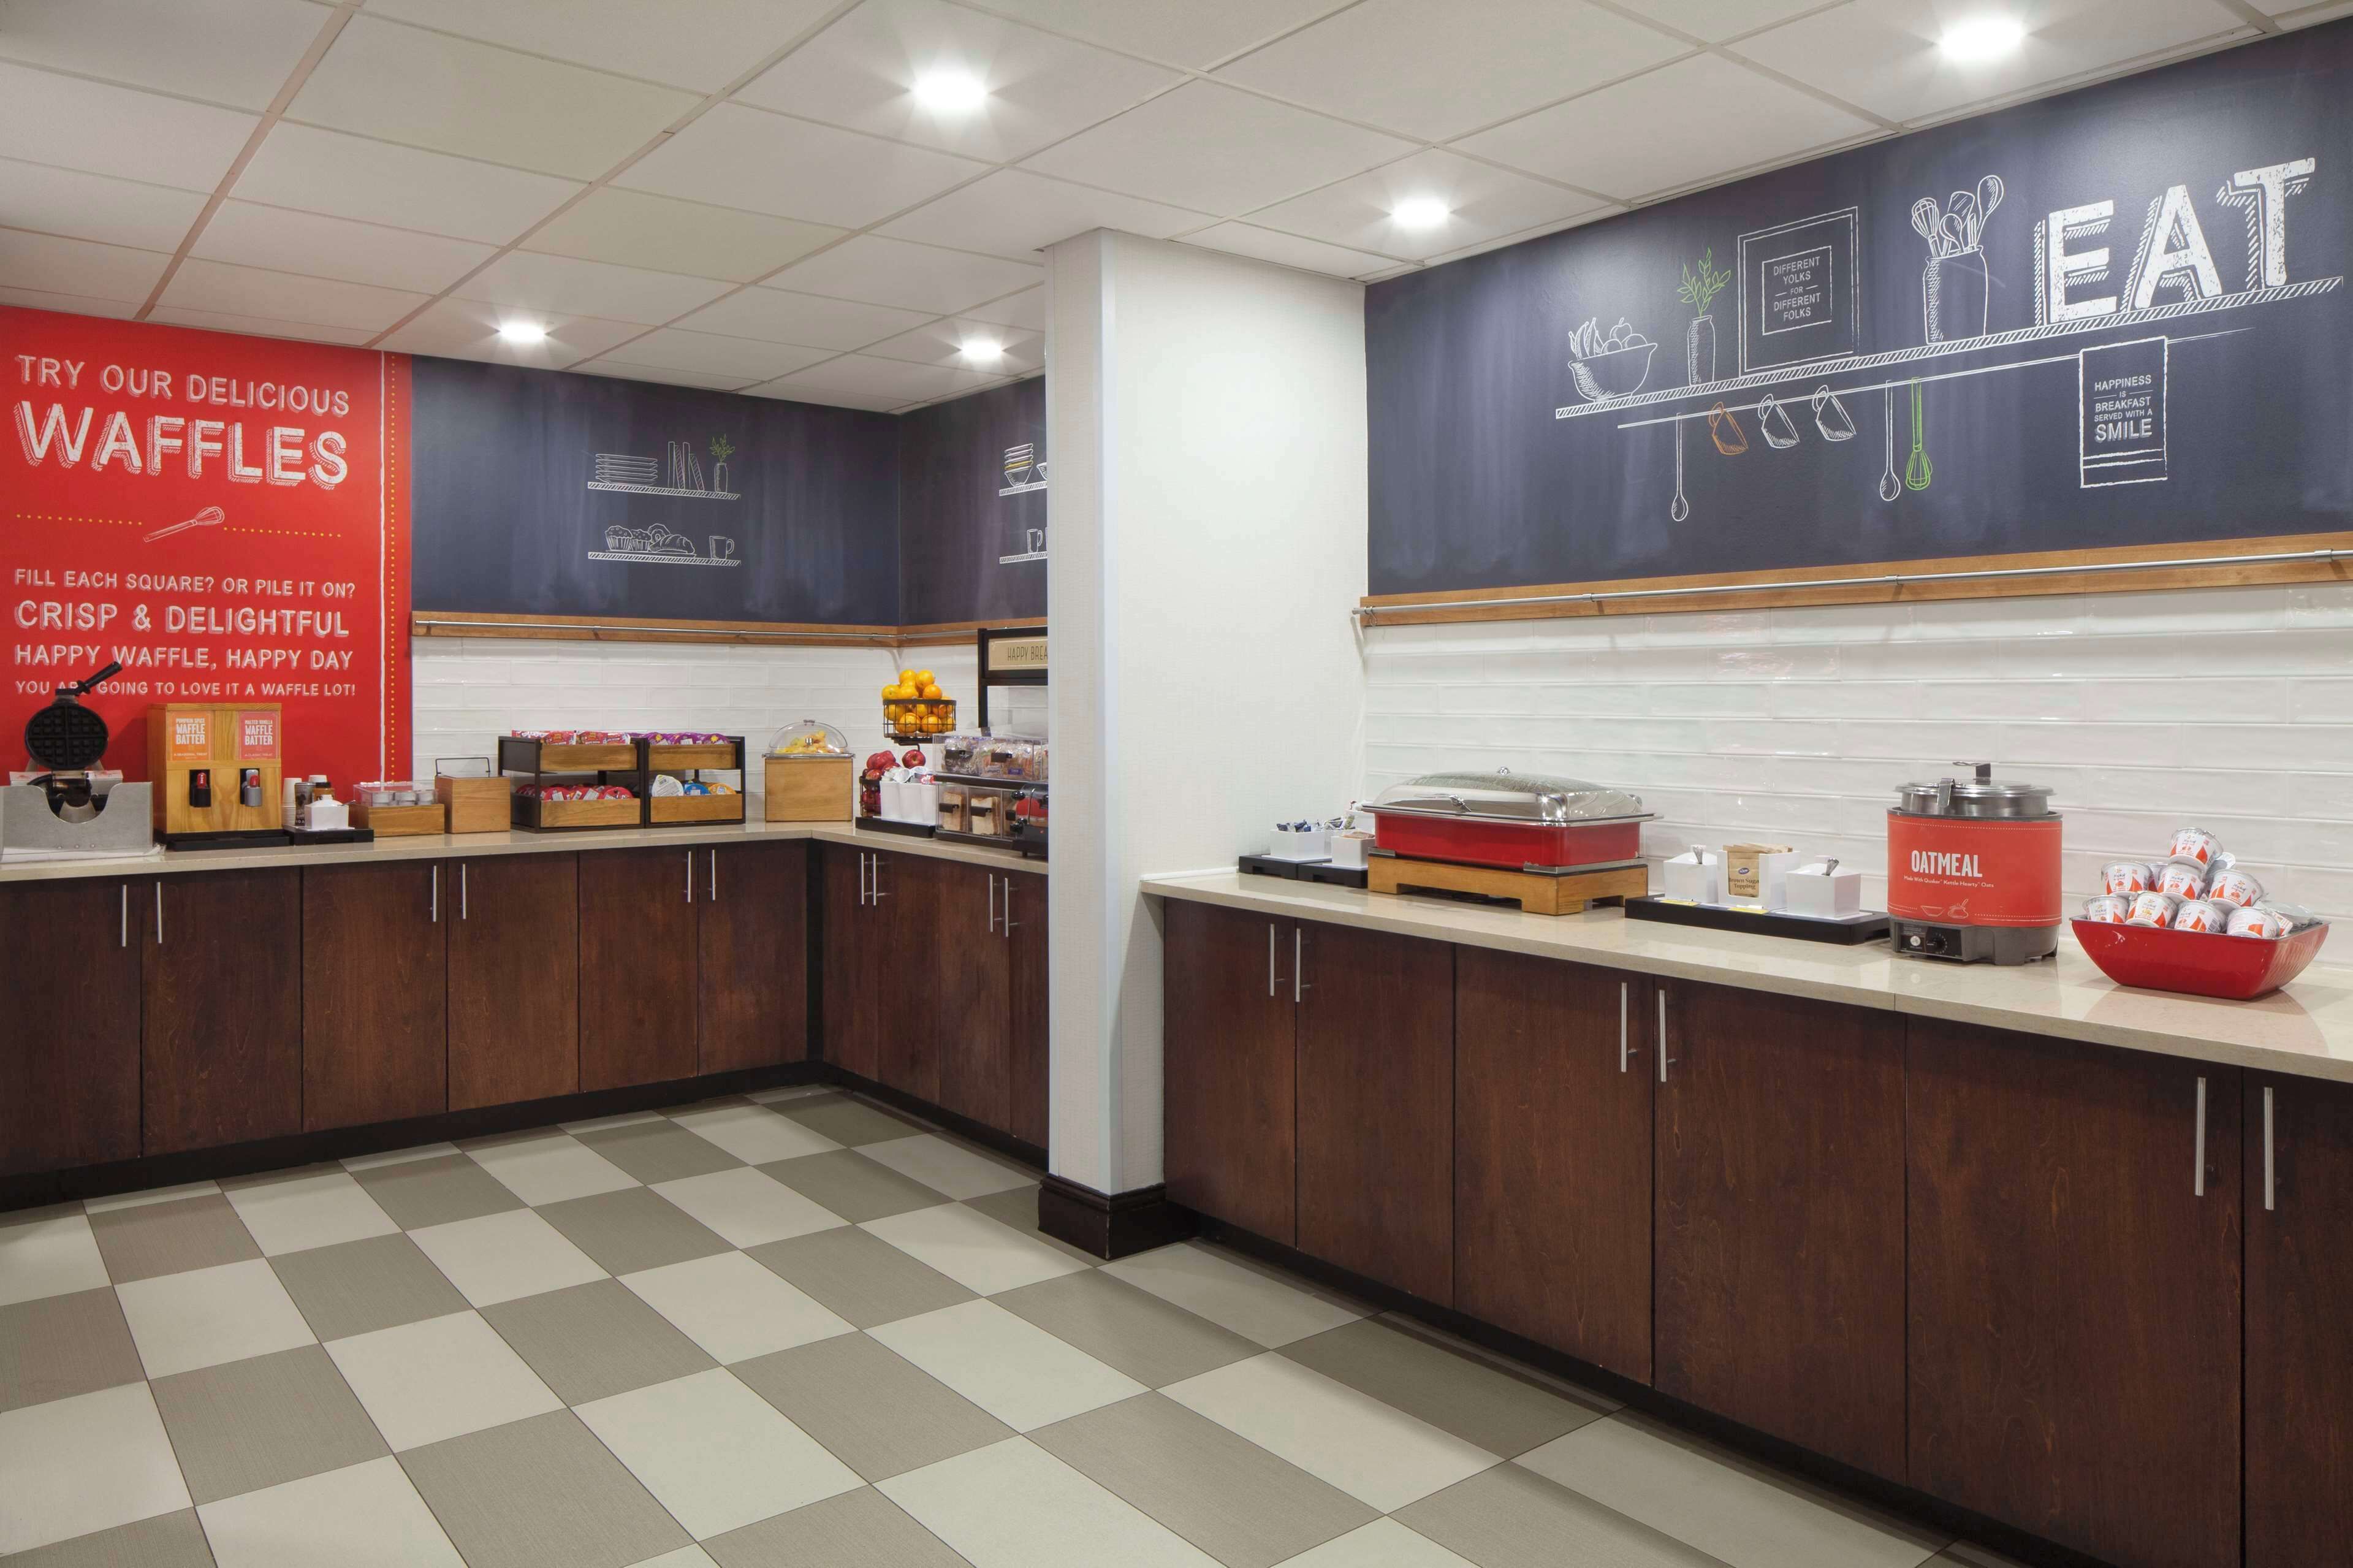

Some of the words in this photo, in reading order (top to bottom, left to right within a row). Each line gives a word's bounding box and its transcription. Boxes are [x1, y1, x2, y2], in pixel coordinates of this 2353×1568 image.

[2034, 157, 2316, 325] EAT
[1774, 256, 1820, 276] DIFFERENT
[1783, 271, 1811, 284] YOLKS
[1790, 286, 1803, 295] FOR
[1774, 292, 1821, 311] DIFFERENT
[1784, 307, 1811, 321] FOLKS
[15, 354, 85, 389] TRY
[100, 364, 172, 398] OUR
[186, 374, 349, 417] DELICIOUS
[2095, 375, 2151, 391] HAPPINESS
[2096, 396, 2151, 413] BREAKFAST
[2094, 412, 2123, 422] SERVED
[2126, 409, 2145, 418] WITH
[2094, 418, 2153, 443] SMILE
[13, 401, 348, 490] WAFFLES
[14, 568, 55, 587] FILL
[64, 571, 118, 588] EACH
[125, 573, 214, 593] SQUARE?
[222, 577, 249, 594] OR
[255, 579, 292, 596] PILE
[298, 581, 314, 597] IT
[321, 581, 355, 598] ON?
[14, 600, 118, 632] CRISP
[132, 603, 152, 631] &
[165, 606, 350, 638] DELIGHTFUL
[14, 644, 101, 666] HAPPY
[111, 645, 218, 671] WAFFLE,
[225, 647, 302, 669] HAPPY
[311, 650, 353, 671] DAY
[1007, 647, 1028, 661] HAPPY
[1030, 645, 1048, 660] BREA
[15, 680, 50, 696] YOU
[96, 681, 148, 696] GOING
[154, 682, 175, 695] TO
[181, 682, 220, 696] LOVE
[226, 683, 239, 696] IT
[245, 683, 255, 696] A
[261, 683, 319, 696] WAFFLE
[324, 683, 356, 696] LOT!
[176, 723, 205, 734] WAFFLE
[245, 725, 273, 734] WAFFLE
[176, 734, 205, 745] BATTER
[245, 735, 273, 745] BATTER
[1911, 850, 1983, 878] OATMEAL
